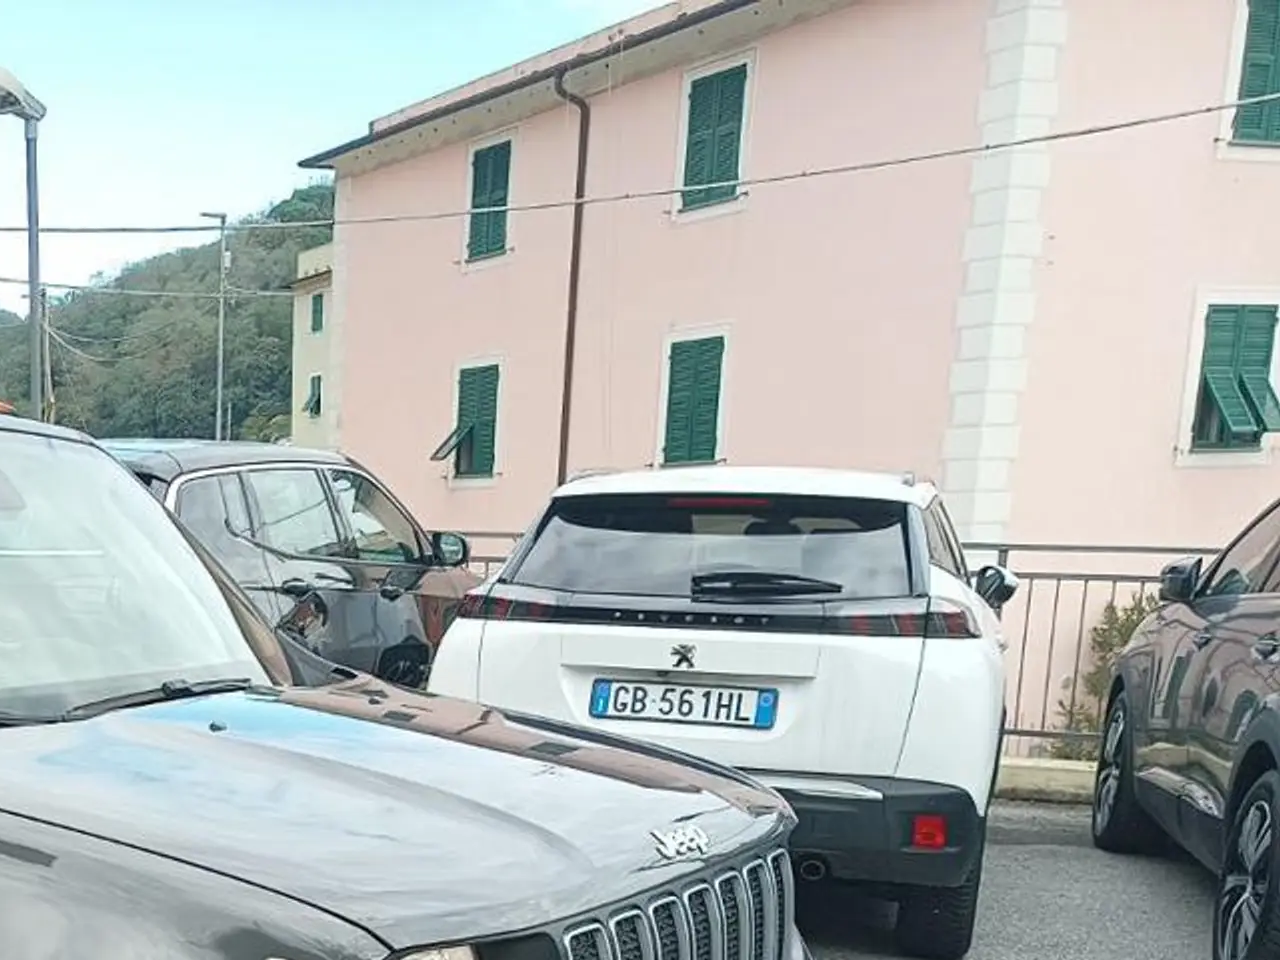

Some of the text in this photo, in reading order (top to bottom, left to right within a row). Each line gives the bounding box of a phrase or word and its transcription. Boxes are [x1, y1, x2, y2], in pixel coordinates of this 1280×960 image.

[612, 685, 648, 714] GB
[658, 688, 751, 722] 561HL
[649, 825, 710, 859] Jeep
